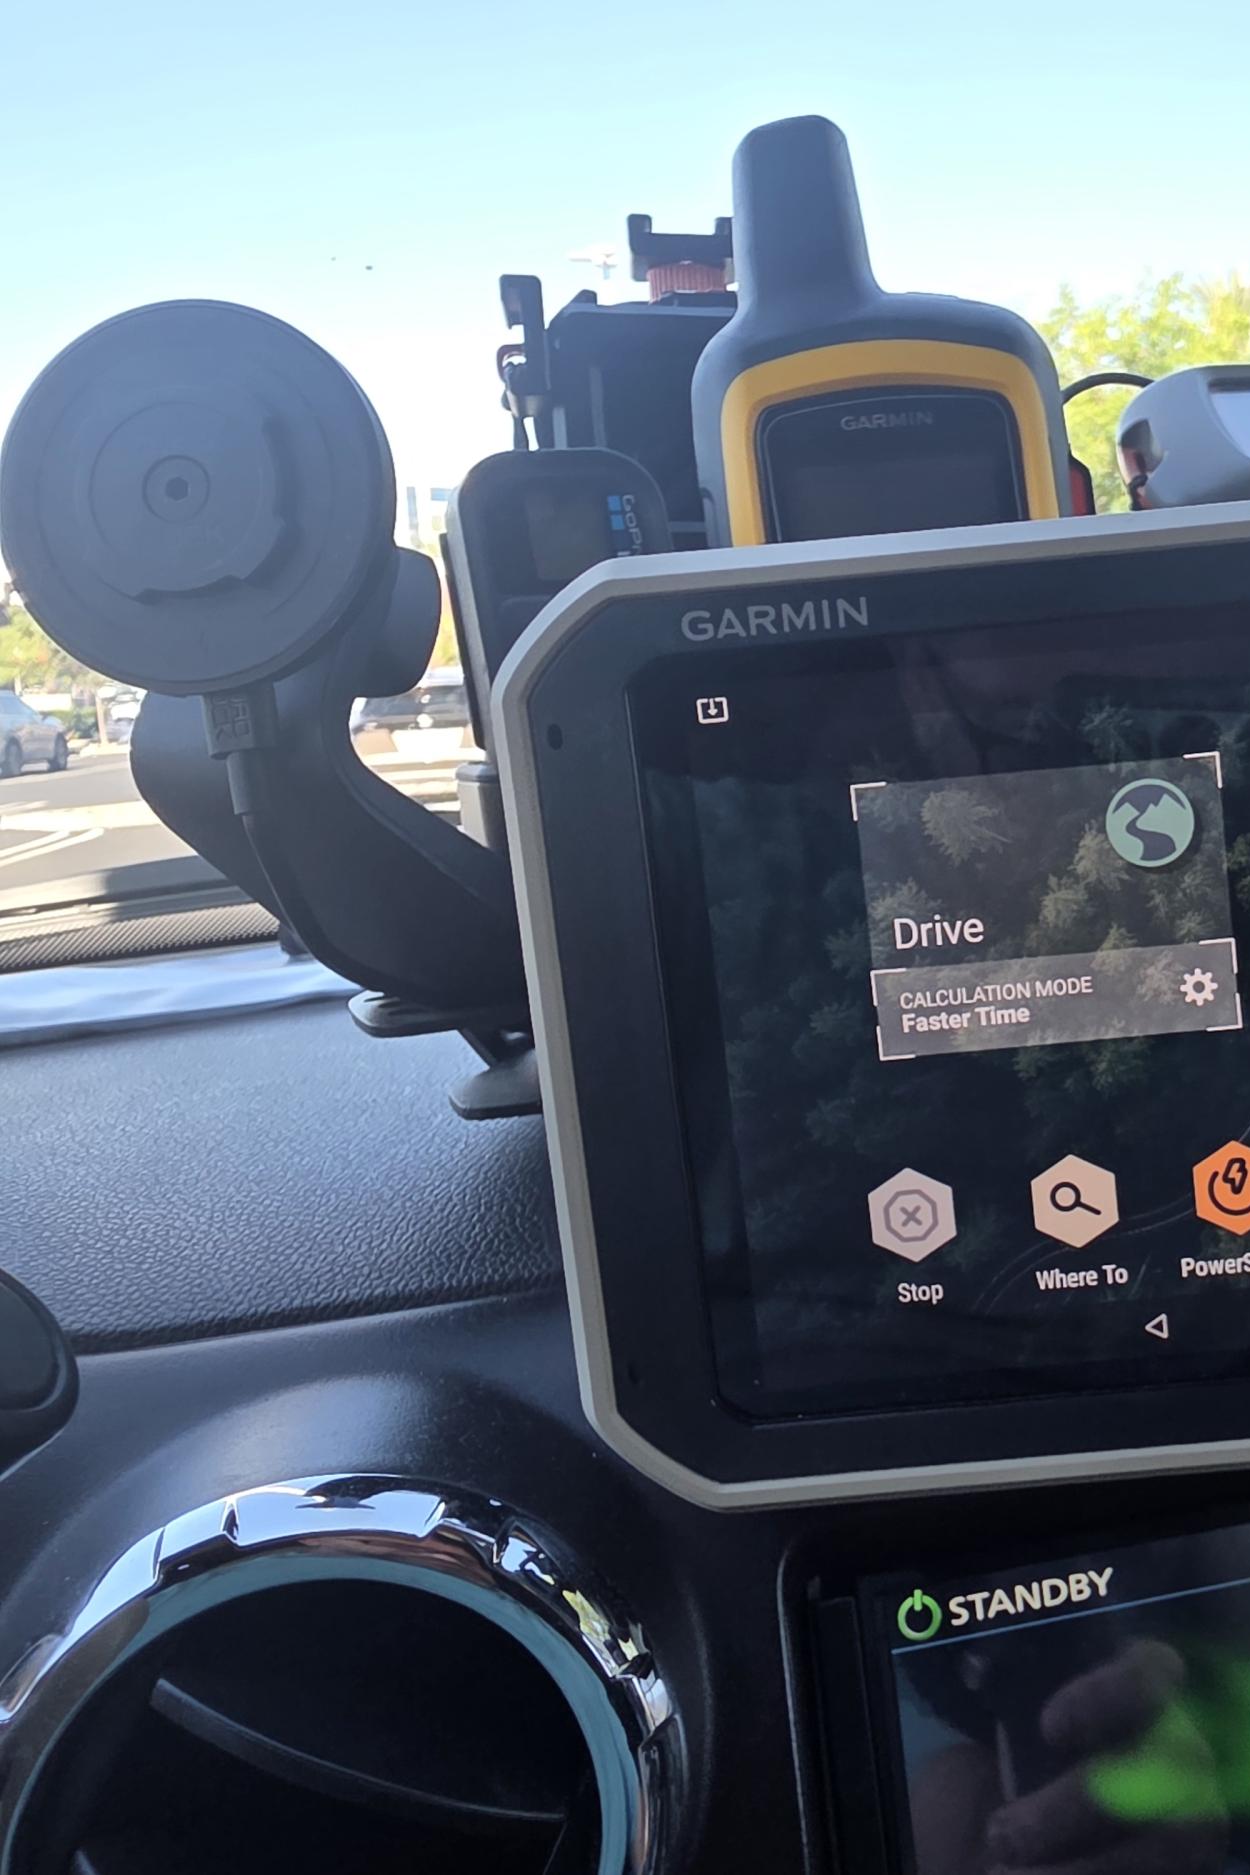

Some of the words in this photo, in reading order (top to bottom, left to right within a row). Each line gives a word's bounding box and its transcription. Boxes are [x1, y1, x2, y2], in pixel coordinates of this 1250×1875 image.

[840, 411, 934, 432] GARMIN
[680, 597, 869, 642] GARMIN
[893, 914, 985, 950] Drive
[900, 982, 1031, 1010] CALCULATION
[1034, 976, 1094, 998] MODE
[901, 1008, 972, 1034] Faster
[975, 1004, 1031, 1027] Time
[1034, 1267, 1099, 1291] Where
[1101, 1263, 1130, 1286] To
[897, 1281, 945, 1306] Stop
[947, 1566, 1114, 1628] STANDBY
